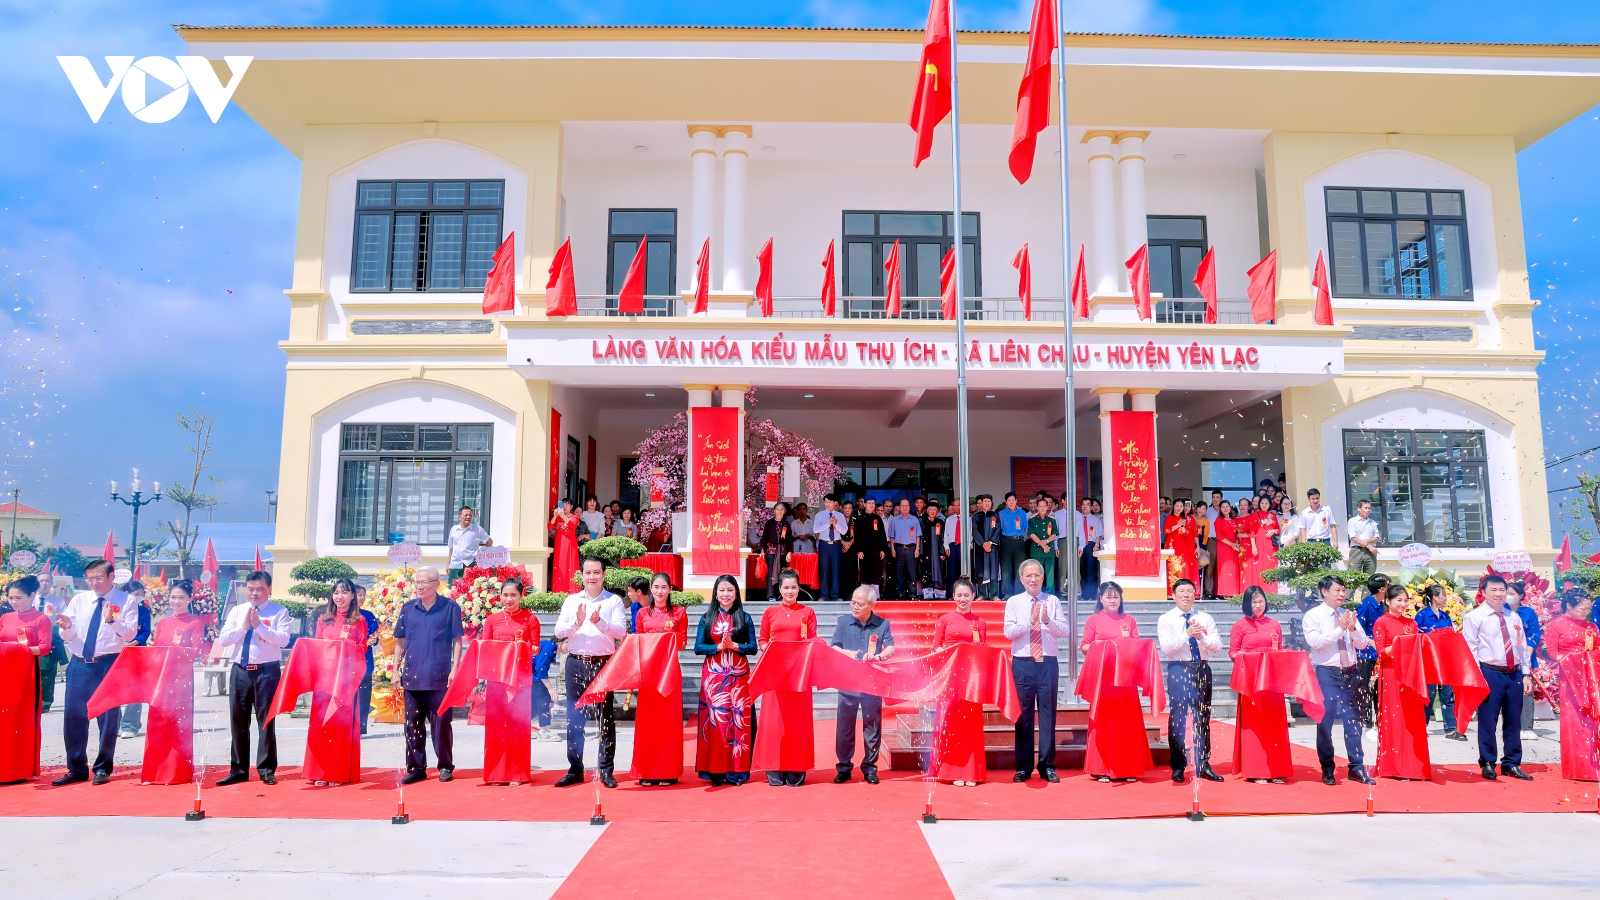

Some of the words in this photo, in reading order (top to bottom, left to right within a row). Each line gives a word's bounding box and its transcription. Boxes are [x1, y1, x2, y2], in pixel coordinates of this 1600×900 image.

[593, 335, 646, 358] LÀNG
[655, 336, 693, 359] VĂN
[701, 335, 742, 360] HÓA
[751, 331, 796, 361] KIỂU
[805, 333, 847, 361] MẪU
[856, 342, 895, 365] THỤ
[904, 337, 936, 361] ÍCH
[989, 338, 1030, 363] LIÊN
[1107, 340, 1170, 368] HUYỆN
[1177, 341, 1215, 365] YÊN
[1220, 346, 1259, 369] LẠC
